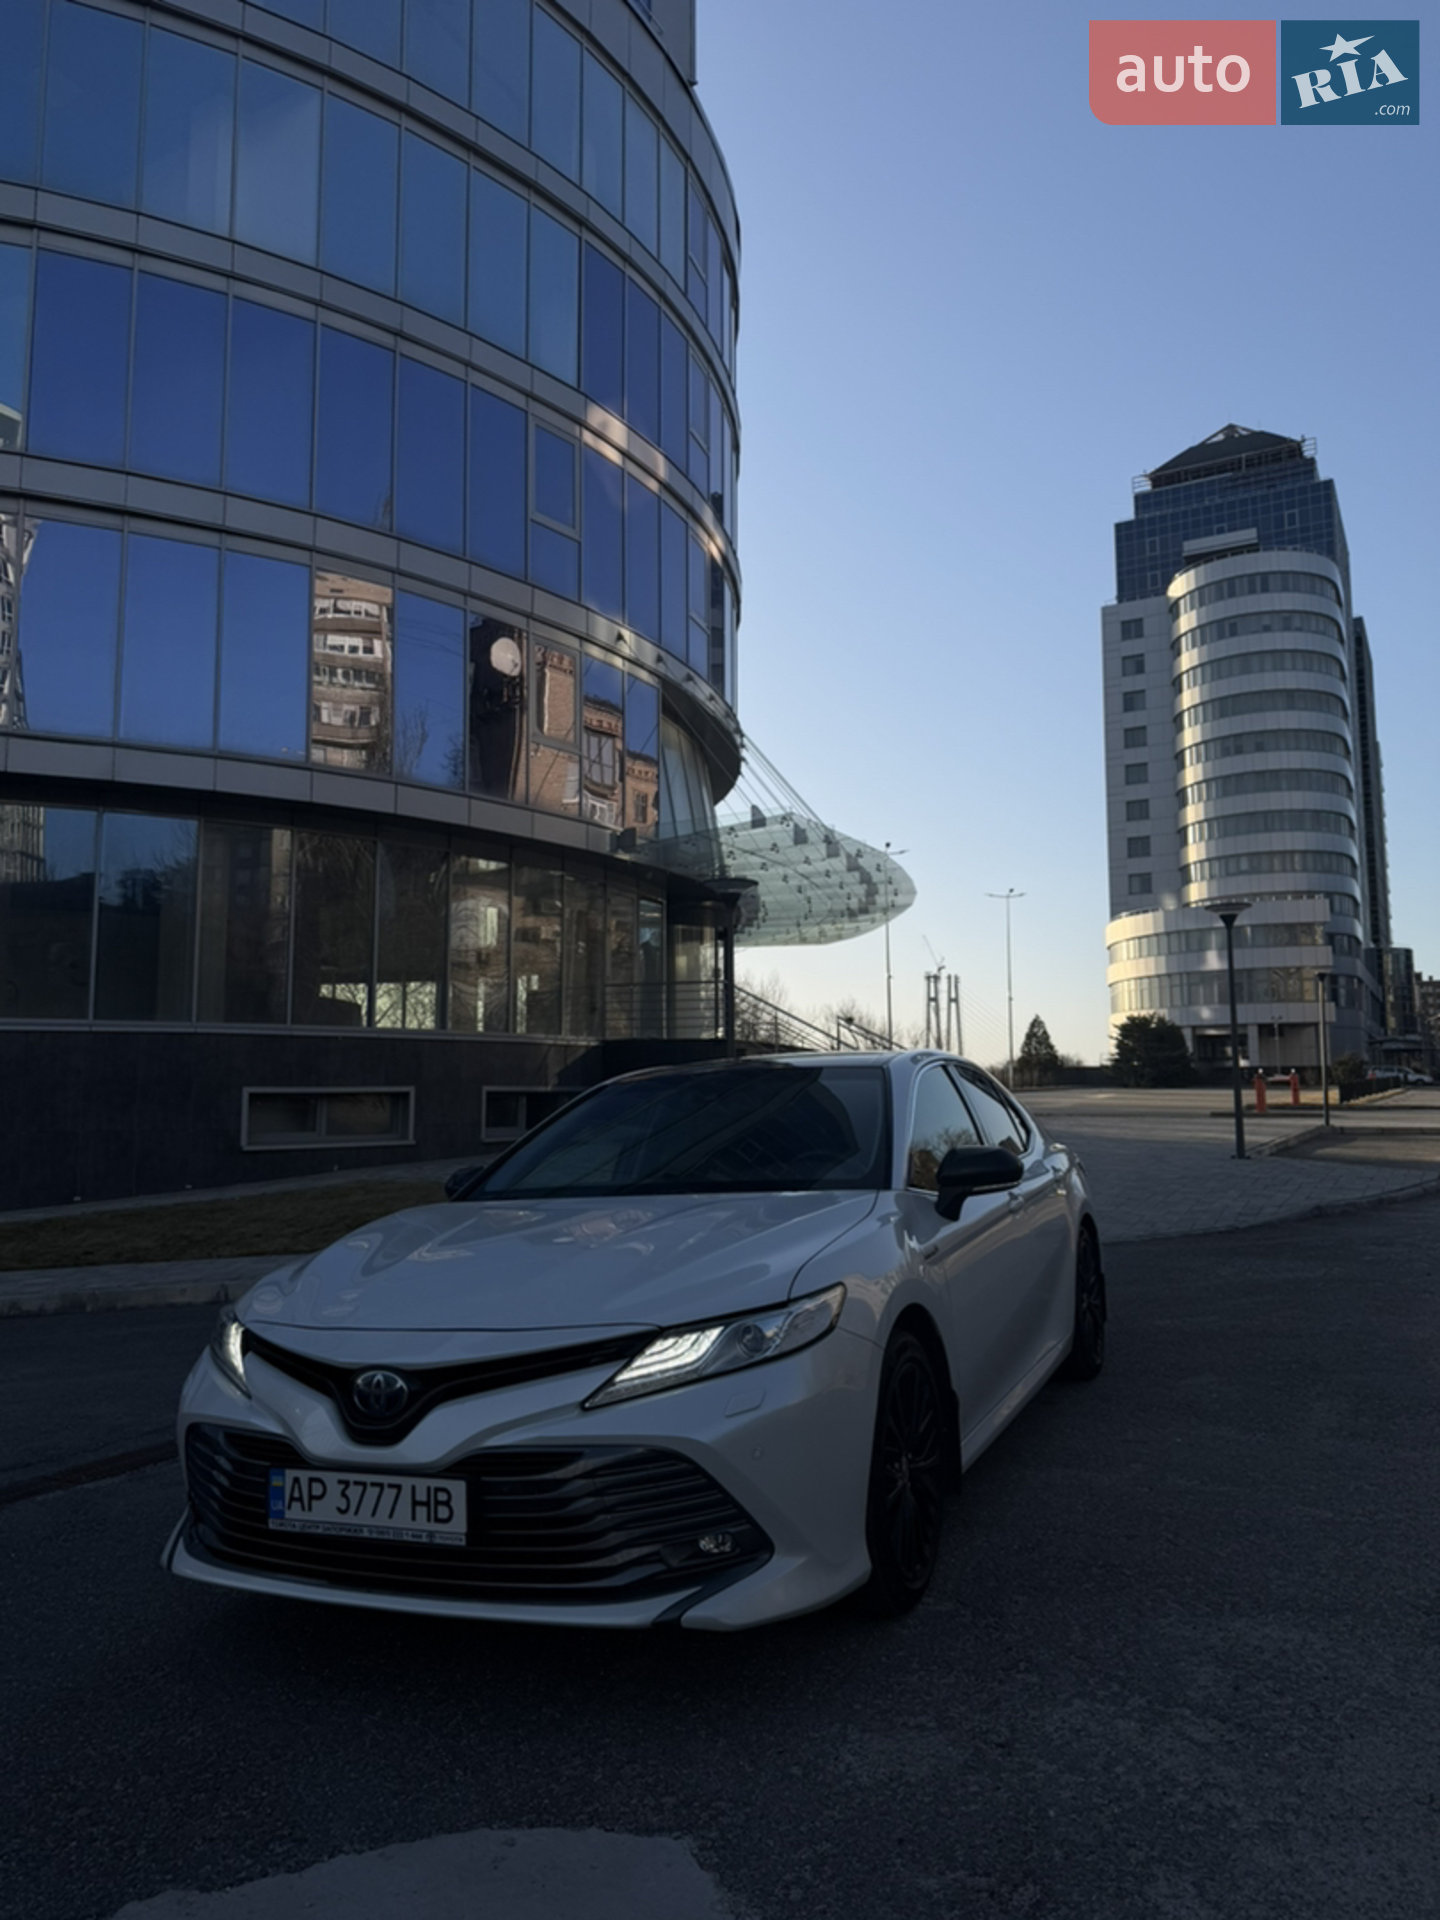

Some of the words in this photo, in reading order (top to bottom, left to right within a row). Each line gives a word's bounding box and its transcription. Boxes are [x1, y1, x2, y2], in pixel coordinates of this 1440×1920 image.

[271, 1500, 284, 1511] UA
[287, 1476, 327, 1512] AP
[336, 1479, 402, 1519] 3777
[411, 1484, 454, 1524] HB
